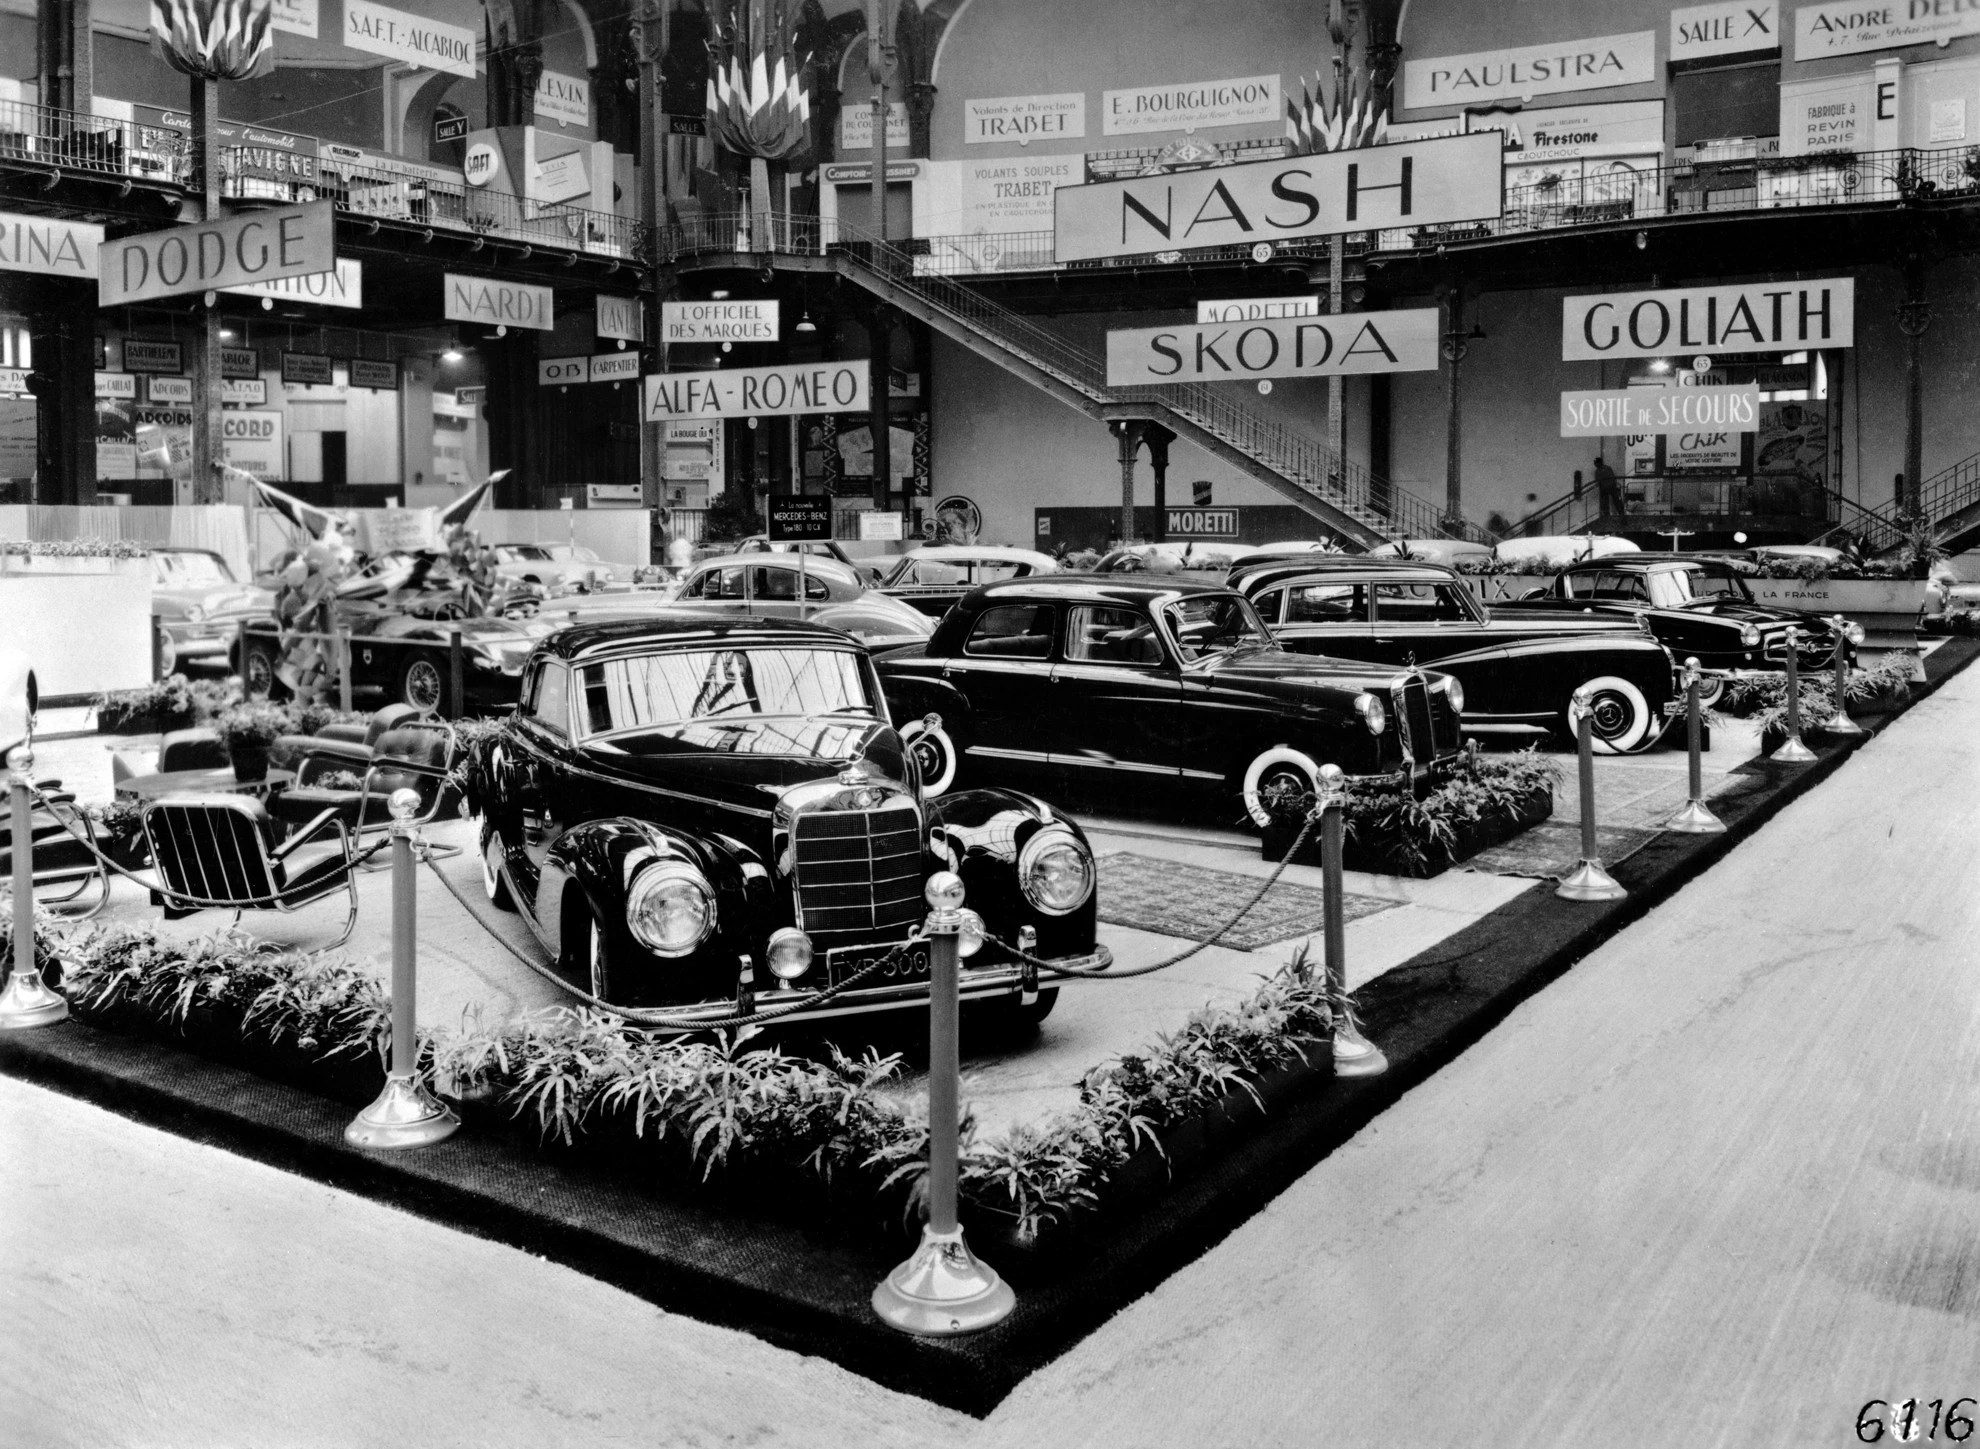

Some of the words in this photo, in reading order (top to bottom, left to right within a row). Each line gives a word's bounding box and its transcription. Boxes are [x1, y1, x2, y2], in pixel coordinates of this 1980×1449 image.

[1678, 16, 1735, 45] SALLE
[1743, 7, 1771, 36] X
[1809, 8, 1894, 36] ANDRE
[1908, 0, 1980, 20] DEL
[406, 27, 471, 64] ALCABLOC
[1430, 50, 1624, 93] PAULSTRA
[1136, 83, 1270, 113] BOURGUIGNON
[1877, 82, 1895, 120] E
[972, 106, 1009, 116] Volants
[1012, 103, 1024, 113] de
[1027, 101, 1076, 112] Direction
[1807, 103, 1847, 119] FABRIQUE
[161, 111, 192, 130] Carda
[241, 127, 296, 149] l'automobile
[439, 124, 456, 138] SALLE
[456, 121, 465, 135] Y
[978, 113, 1068, 136] TRABET
[1807, 119, 1855, 133] REVIN
[1533, 131, 1599, 149] Firestone
[1807, 132, 1855, 146] PARIS
[241, 145, 312, 178] AVIGNE
[466, 153, 491, 175] SAFT
[1516, 147, 1580, 161] CAOUTCHOUC
[974, 167, 1018, 179] VOLANTS
[1024, 164, 1069, 177] SOUPLES
[994, 180, 1052, 198] TRABET
[1121, 155, 1413, 245] NASH
[122, 214, 305, 293] DODGE
[1256, 246, 1269, 258] 65
[455, 281, 543, 324] NARDI
[600, 300, 641, 334] CANT
[681, 305, 763, 321] L'OFFICIEL
[1583, 288, 1831, 351] GOLIATH
[669, 323, 696, 338] DES
[702, 322, 772, 339] MARQUES
[1147, 319, 1399, 376] SKODA
[593, 358, 637, 376] CARPENTIER
[1683, 373, 1724, 386] CHIK
[135, 411, 193, 425] ADCOIDS
[1566, 397, 1632, 429] SORTIE
[1638, 408, 1652, 425] DE
[1657, 392, 1753, 425] SECOURS
[1679, 431, 1728, 451] Chik
[773, 511, 828, 521] MERCEDES-BENZ
[1168, 511, 1234, 533] MORETTI
[782, 523, 793, 533] Type
[1763, 591, 1777, 599] LA
[1784, 591, 1830, 599] FRANCE
